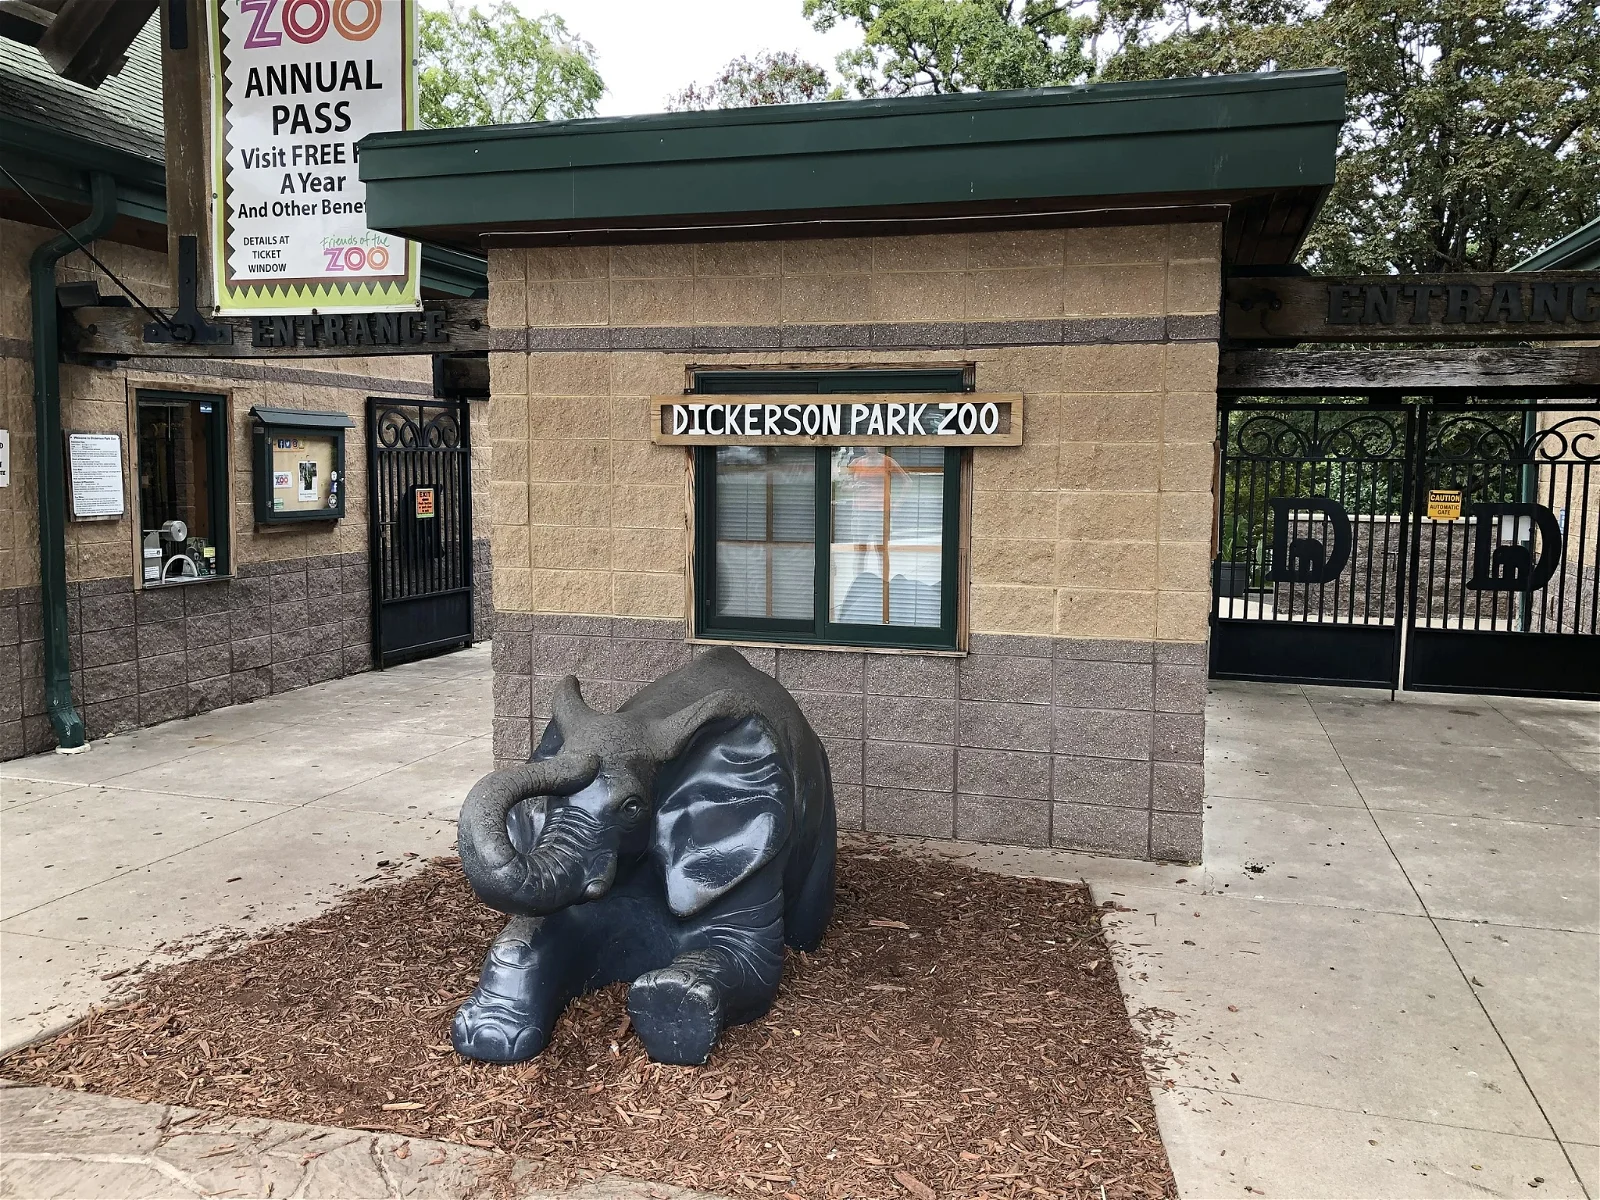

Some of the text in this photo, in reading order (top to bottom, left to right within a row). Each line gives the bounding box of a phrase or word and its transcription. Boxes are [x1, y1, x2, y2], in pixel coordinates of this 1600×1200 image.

[241, 0, 382, 49] ZOO
[245, 59, 383, 98] ANNUAL
[272, 101, 352, 135] PASS
[241, 145, 286, 169] Visit
[292, 142, 346, 166] FREE
[280, 172, 346, 194] A Year
[238, 201, 268, 218] And
[272, 200, 318, 217] Other
[243, 235, 290, 246] DETAILS AT
[320, 231, 390, 250] Friends of the
[252, 249, 281, 259] TICKET
[324, 247, 389, 271] ZOO
[248, 263, 287, 273] WINDOW
[250, 311, 448, 347] ENTRANCE
[672, 402, 999, 436] DICKERSON PARK ZOO
[1430, 494, 1460, 502] CAUTION
